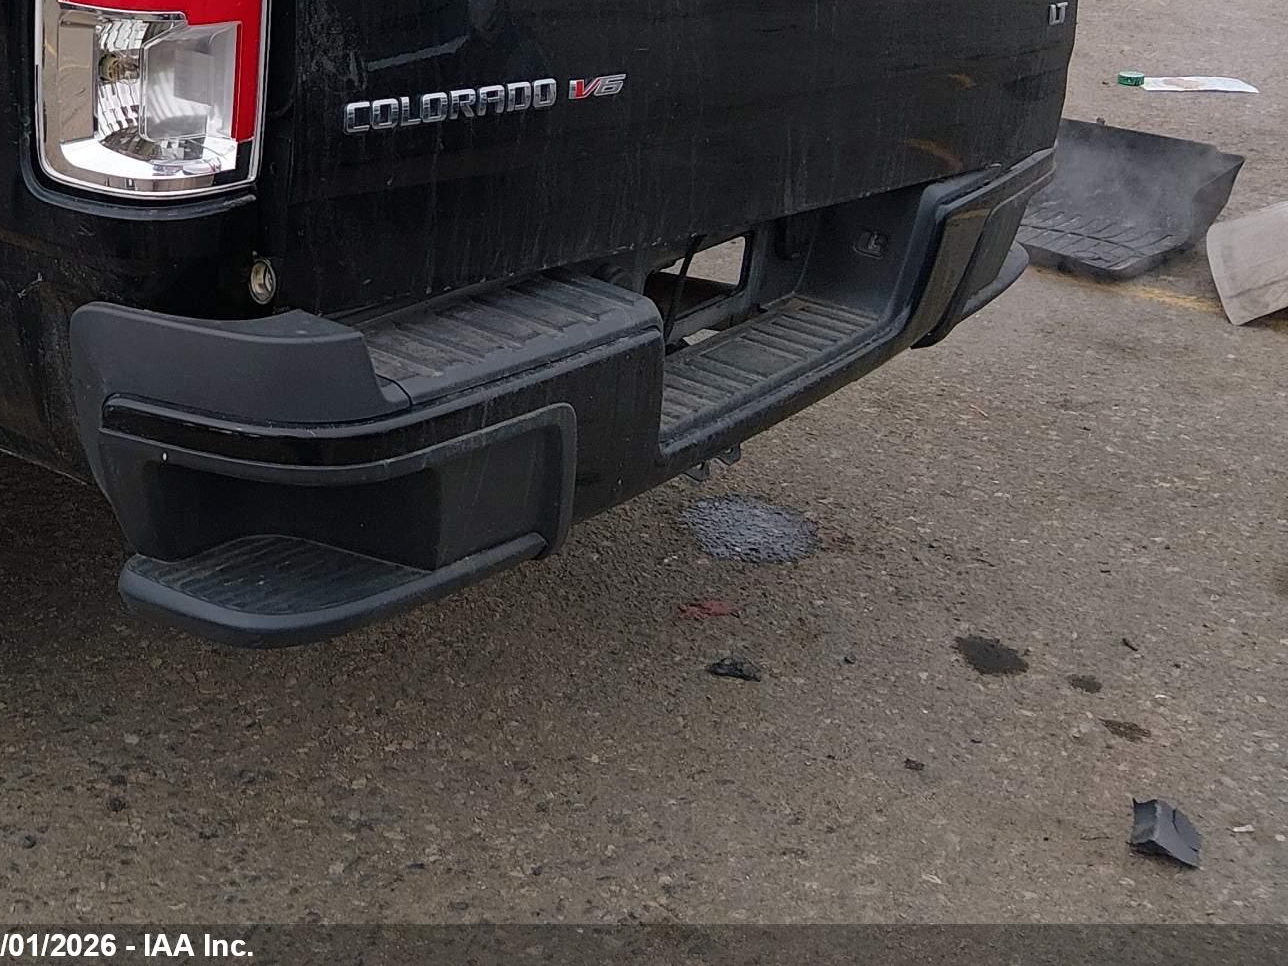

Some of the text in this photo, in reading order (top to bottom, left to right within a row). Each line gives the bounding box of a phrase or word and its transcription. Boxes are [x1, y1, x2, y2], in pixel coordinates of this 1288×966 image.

[1048, 1, 1069, 25] LT
[343, 73, 627, 134] COLORADO V6
